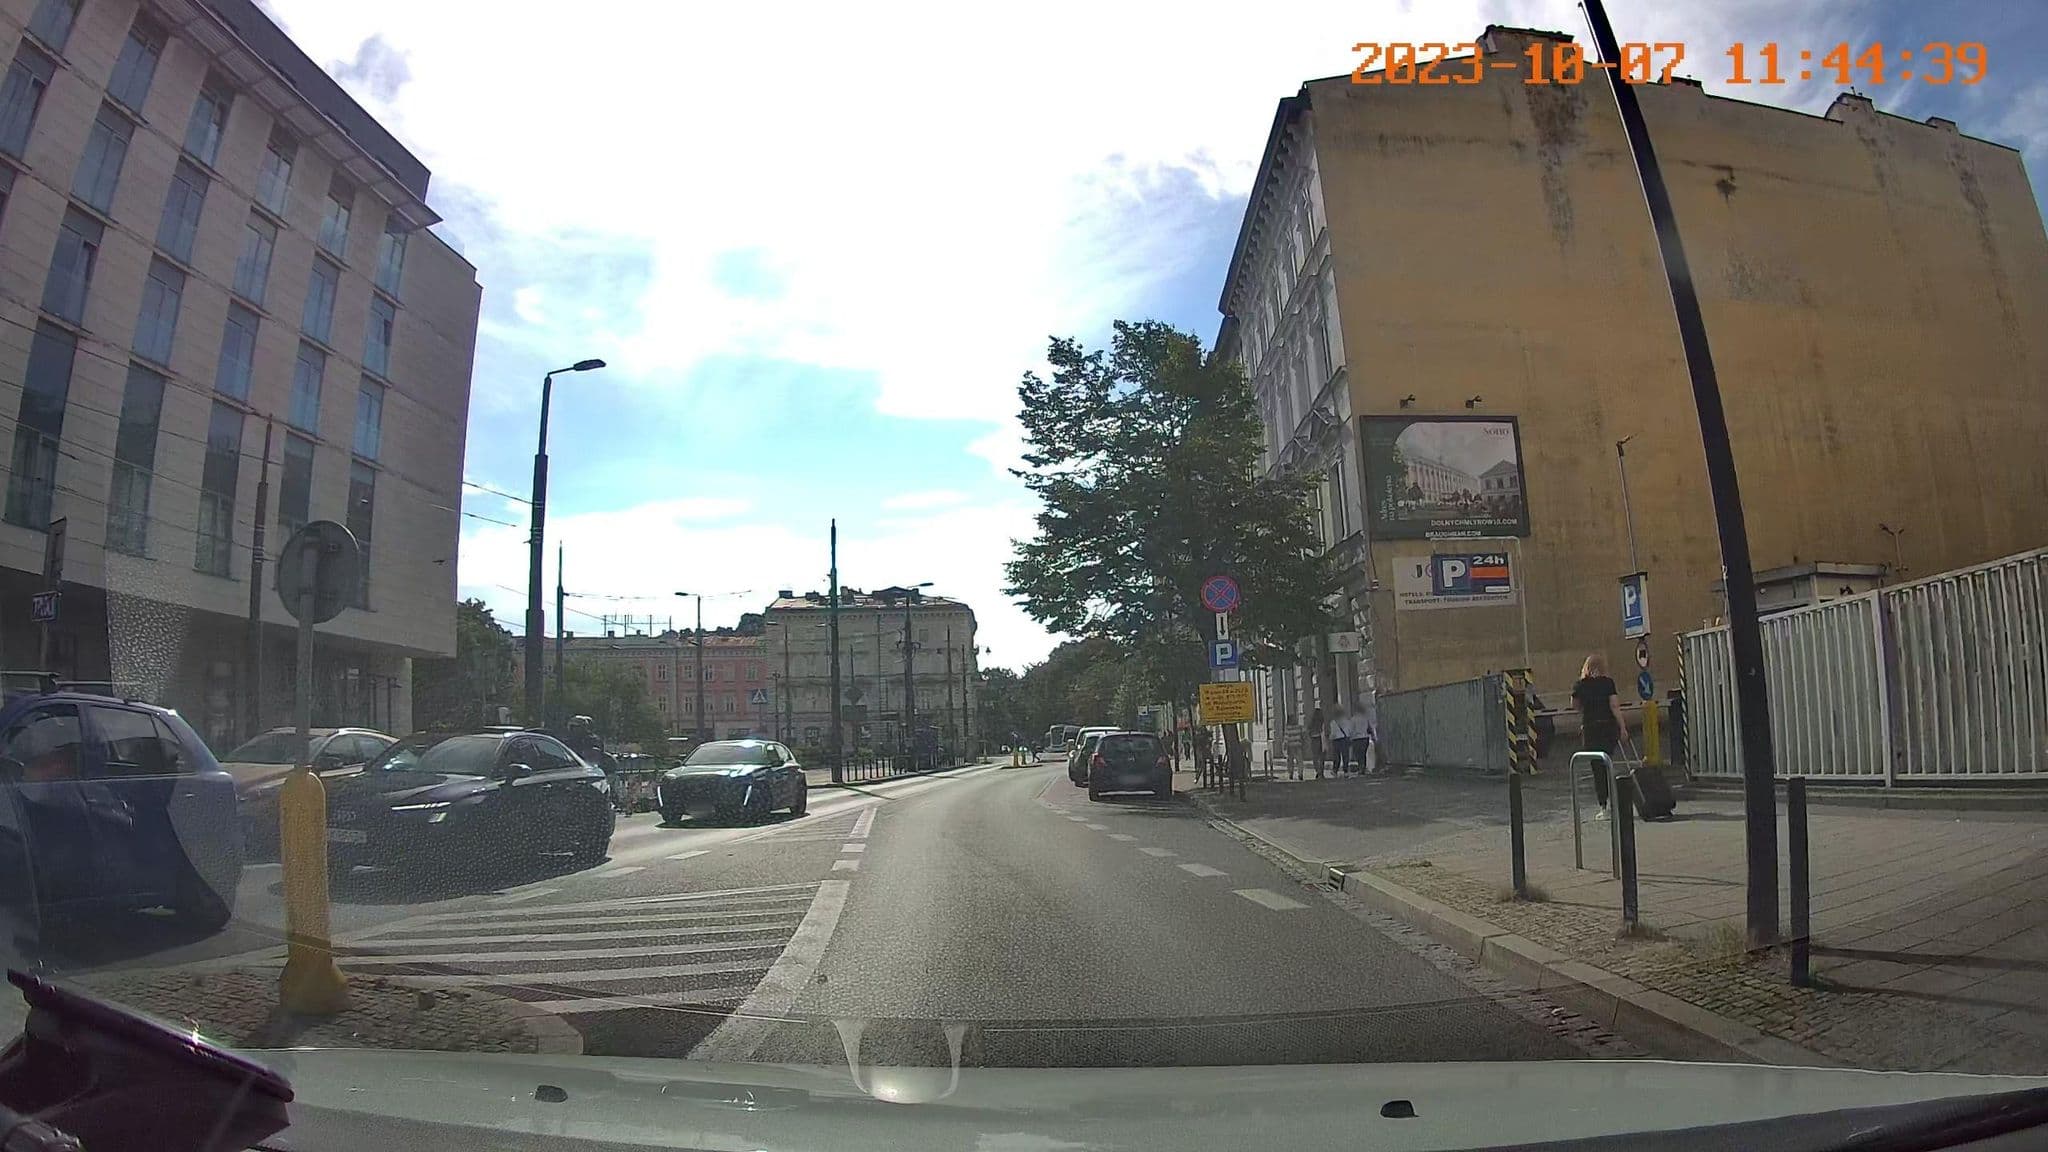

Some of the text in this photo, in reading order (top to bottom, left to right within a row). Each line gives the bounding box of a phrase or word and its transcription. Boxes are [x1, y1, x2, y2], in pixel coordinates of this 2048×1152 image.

[1442, 559, 1466, 588] P
[1472, 555, 1505, 566] 24h
[1623, 584, 1637, 618] P
[1215, 643, 1233, 666] P
